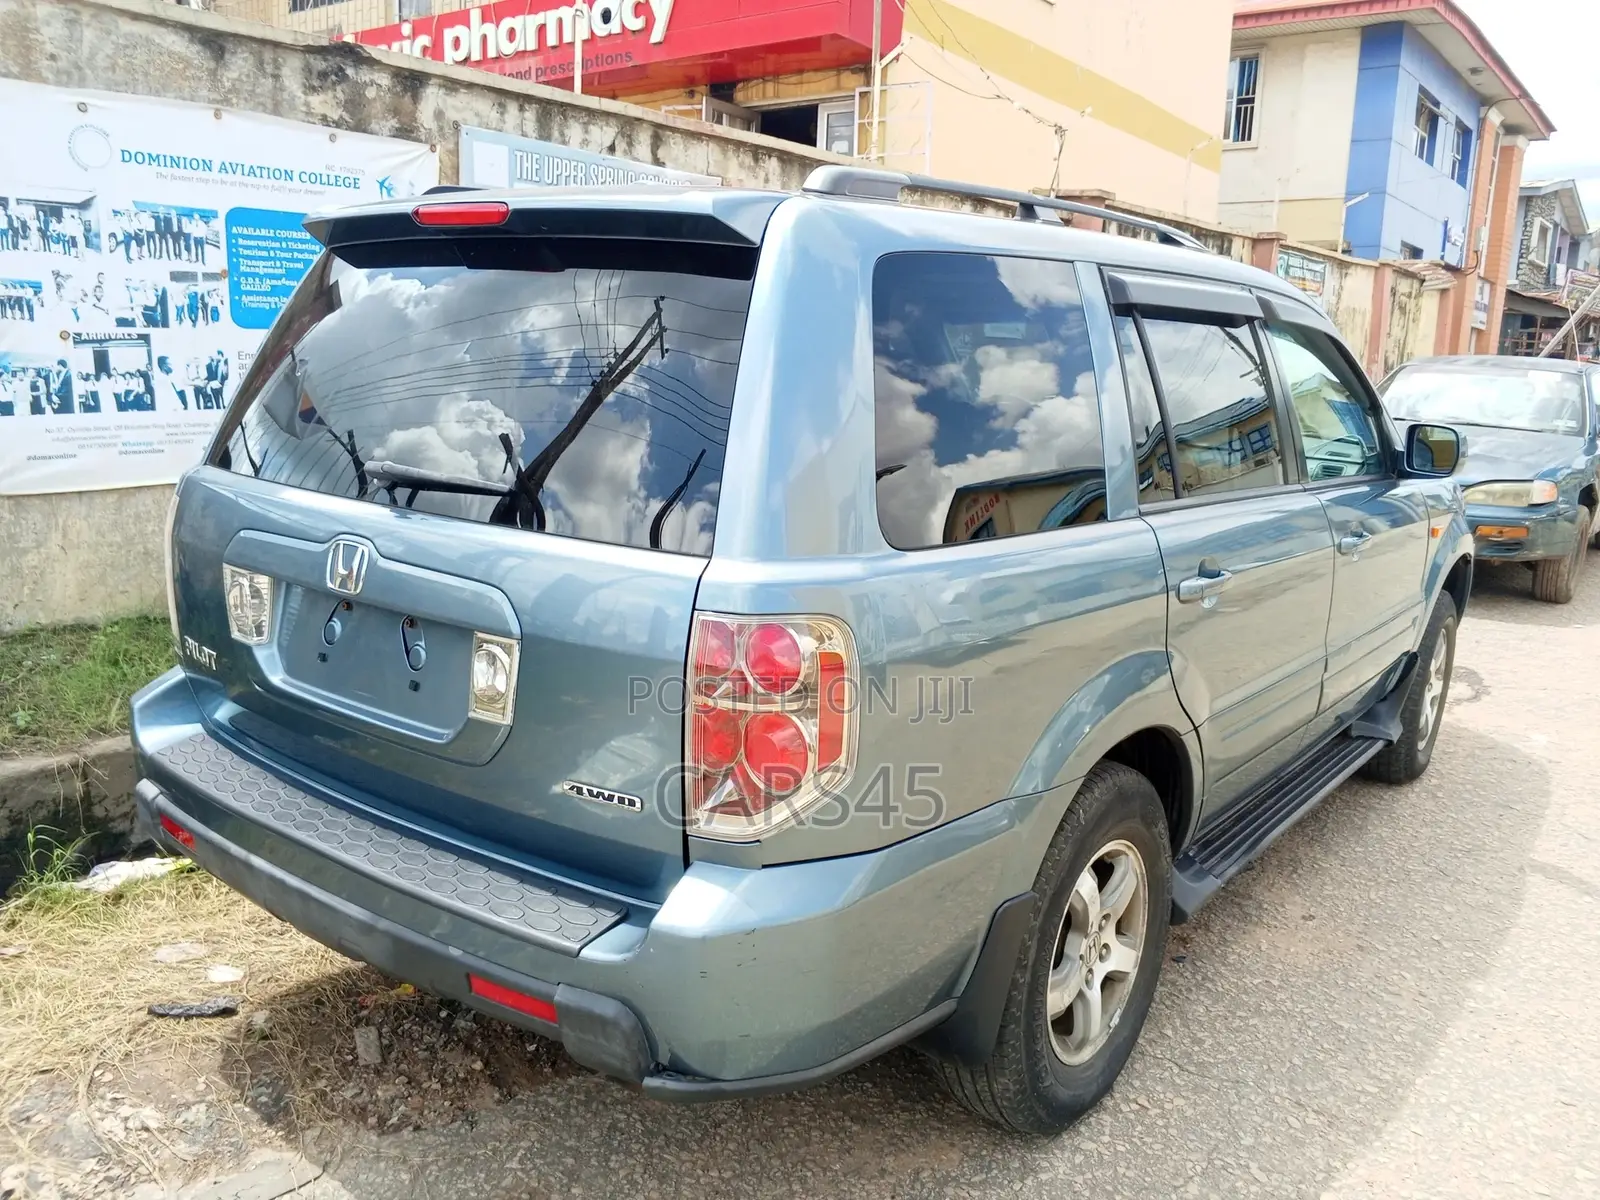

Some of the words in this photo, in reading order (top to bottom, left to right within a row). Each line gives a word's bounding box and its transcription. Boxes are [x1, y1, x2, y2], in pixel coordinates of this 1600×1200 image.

[443, 0, 674, 65] pharmacy
[536, 51, 633, 80] presciptions
[120, 149, 214, 173] DOMINION
[217, 161, 295, 183] AVIATION
[298, 171, 361, 190] COLLEGE
[514, 151, 541, 182] THE
[544, 156, 586, 187] UPPER
[155, 171, 168, 180] The
[170, 172, 194, 182] fastest
[195, 177, 210, 186] step
[232, 226, 275, 237] AVAILABLE
[275, 231, 311, 240] COURSES
[287, 242, 320, 253] Ticketing
[239, 257, 275, 268] Transport
[281, 260, 304, 269] Travel
[240, 266, 286, 275] Management
[81, 332, 138, 341] ARRIVALS
[26, 452, 78, 462] @domaconline
